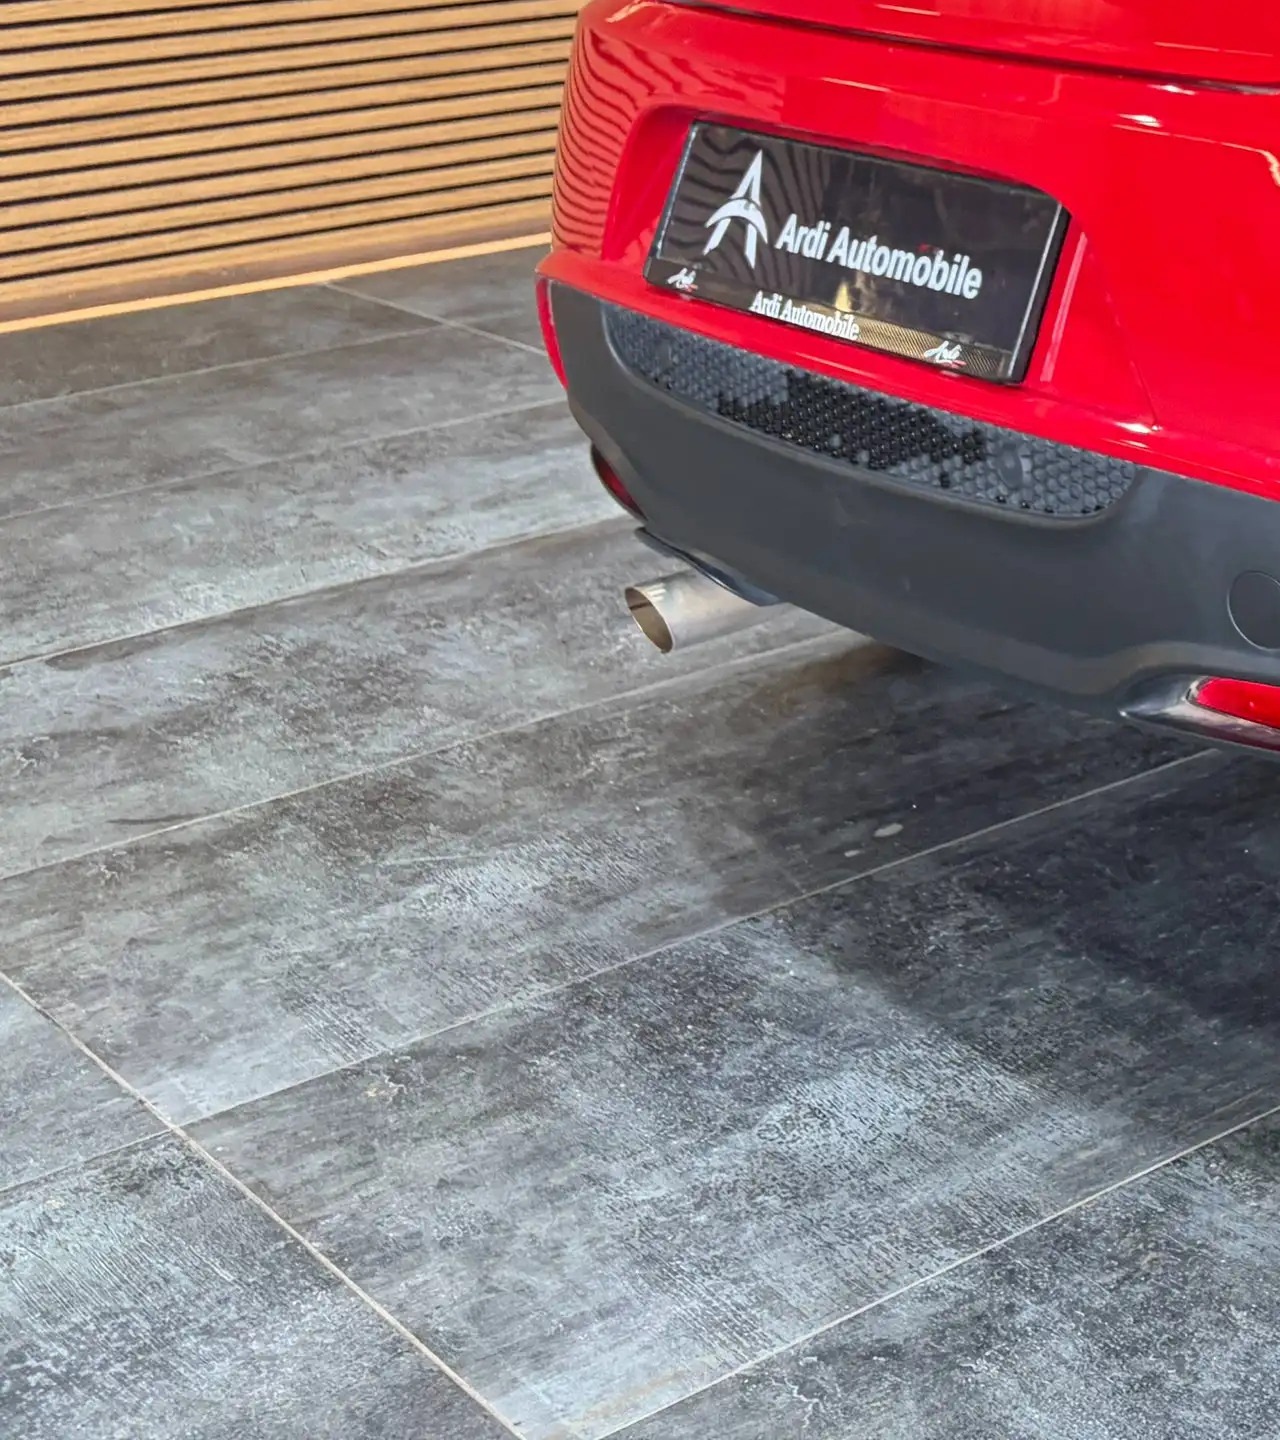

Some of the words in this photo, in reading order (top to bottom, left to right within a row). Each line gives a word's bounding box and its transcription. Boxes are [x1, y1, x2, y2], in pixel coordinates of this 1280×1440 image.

[774, 213, 832, 260] Ardi
[826, 226, 983, 300] Automobile
[748, 290, 783, 319] Ardi
[780, 299, 860, 341] Automobile
